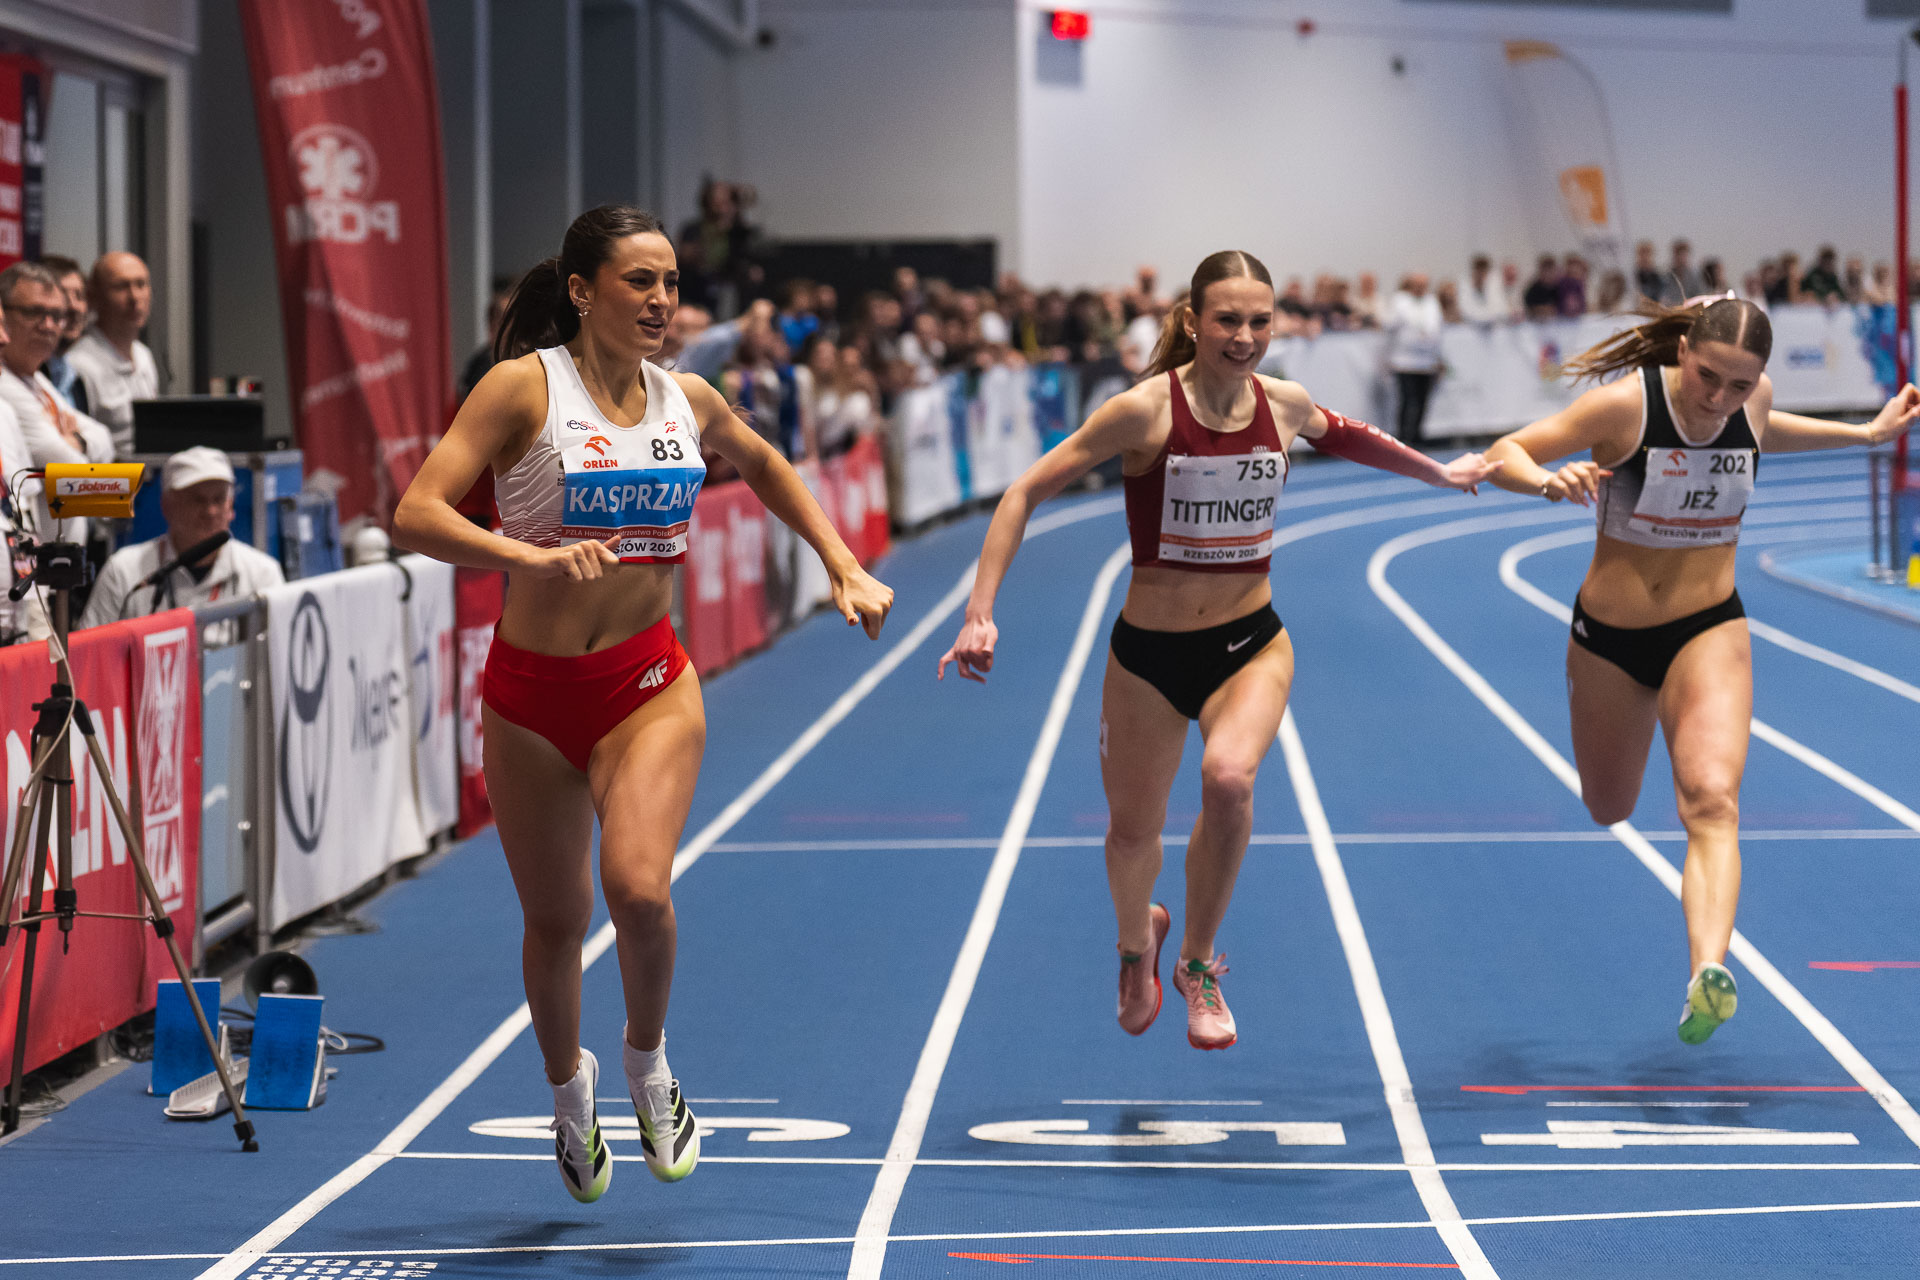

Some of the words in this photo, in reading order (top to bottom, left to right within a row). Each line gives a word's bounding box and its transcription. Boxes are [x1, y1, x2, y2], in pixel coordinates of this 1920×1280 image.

[651, 438, 684, 462] 83
[583, 459, 618, 469] ORLEN
[1237, 459, 1278, 481] 753
[1709, 453, 1747, 475] 202
[78, 481, 121, 492] polanik
[569, 481, 700, 513] KASPRZAK
[1679, 485, 1719, 511] JEŻ
[1170, 496, 1275, 525] TITTINGER
[650, 541, 677, 553] 2026
[1183, 548, 1236, 560] RZESZÓW
[638, 658, 668, 690] 4F
[968, 1119, 1347, 1147] 5
